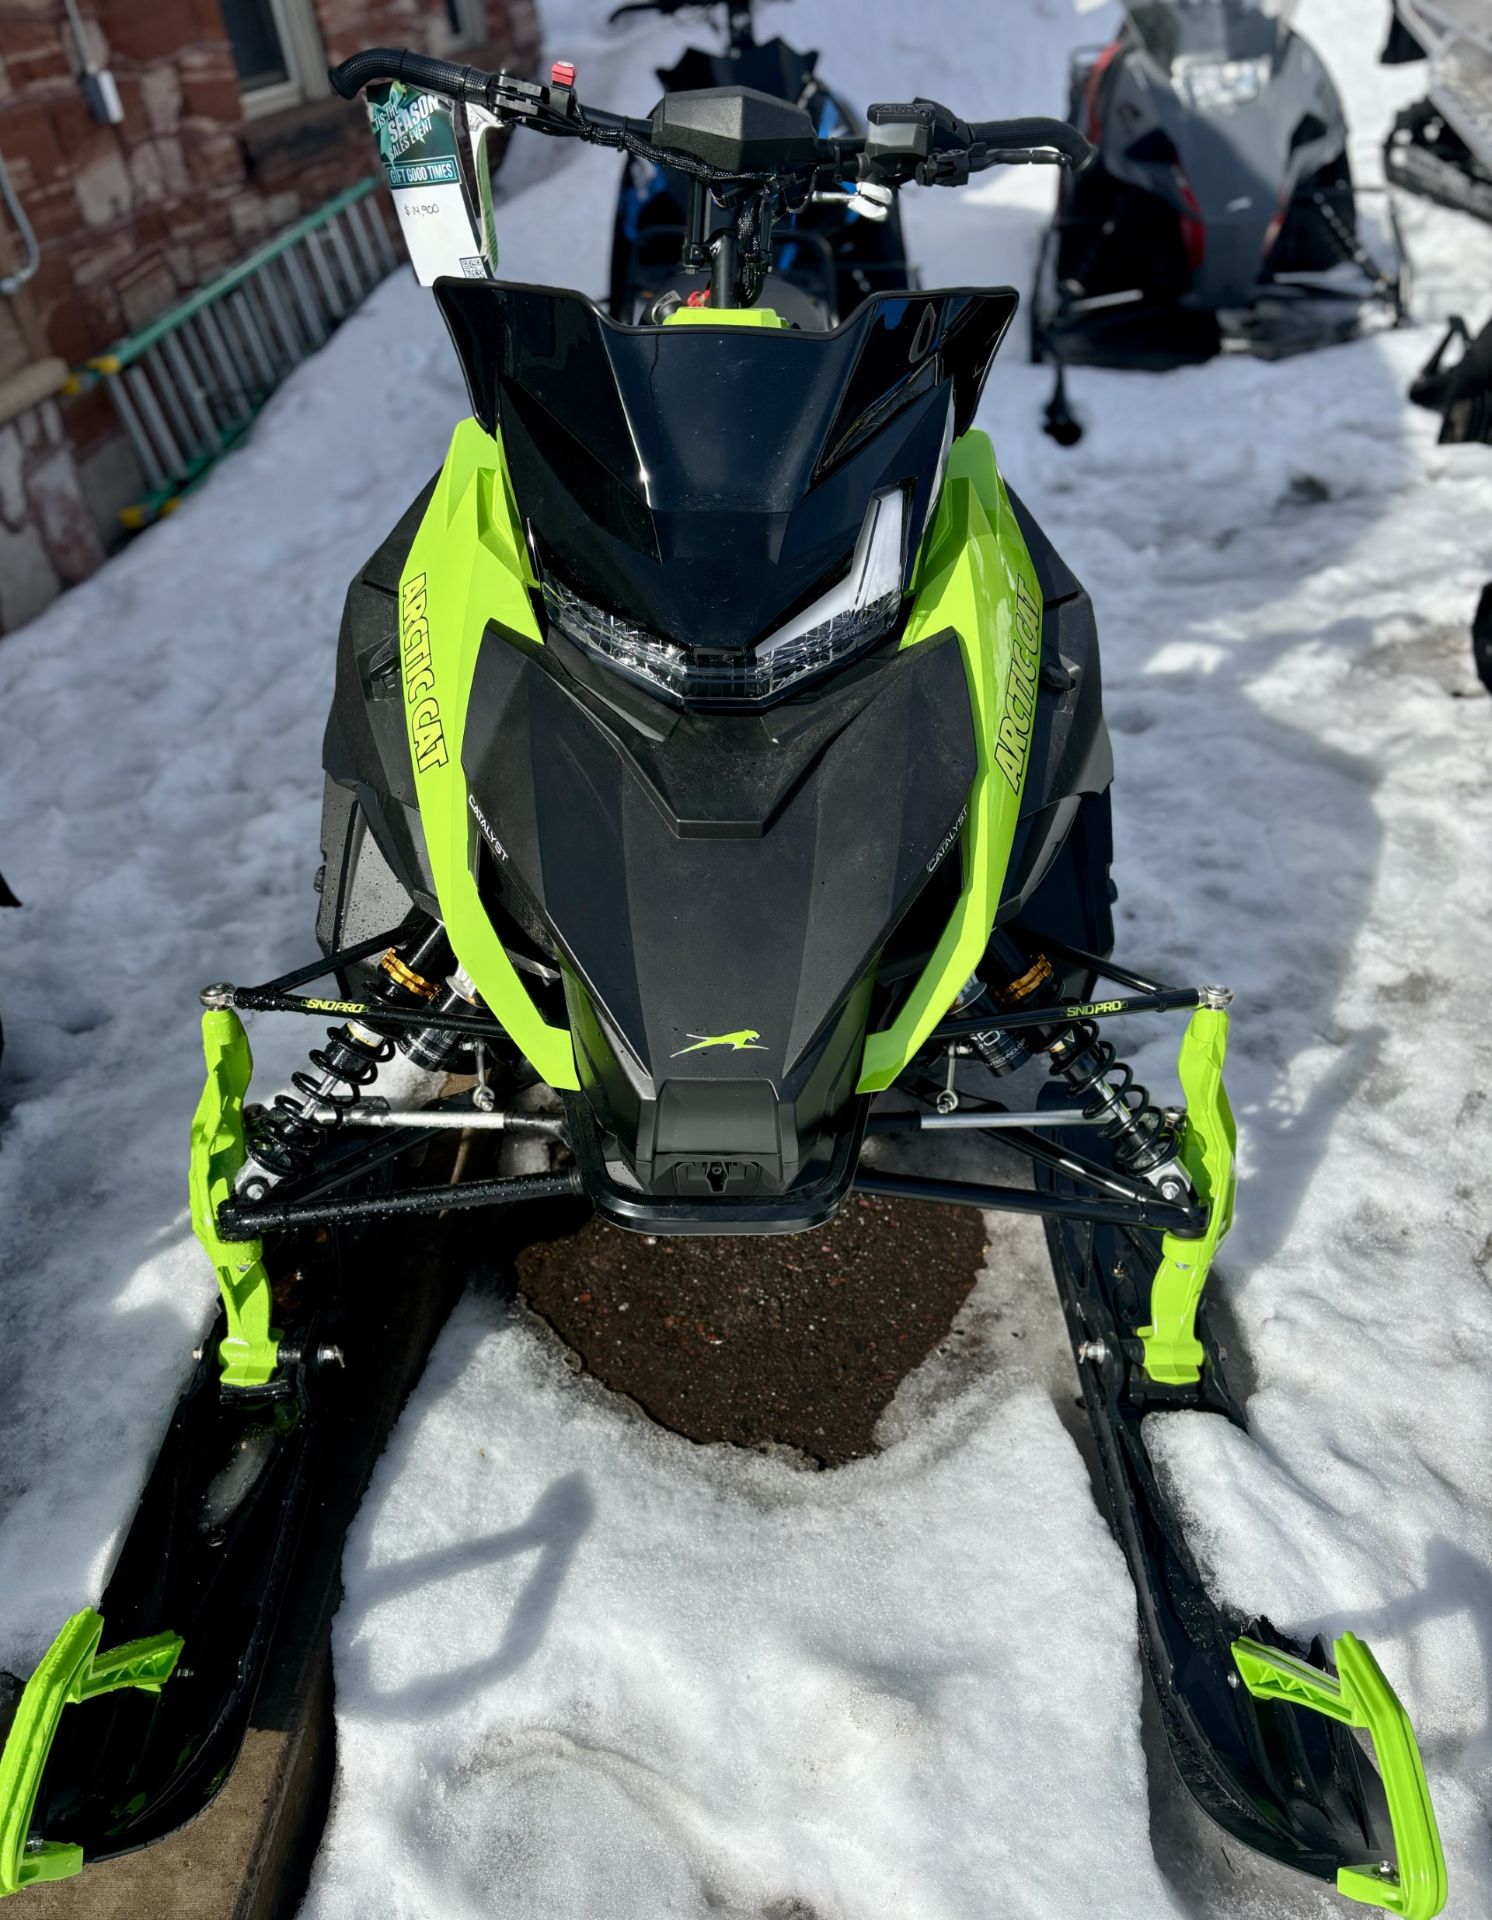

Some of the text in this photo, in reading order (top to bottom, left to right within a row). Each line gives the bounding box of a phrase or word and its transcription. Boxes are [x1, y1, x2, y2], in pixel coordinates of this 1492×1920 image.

[388, 94, 440, 144] SEASON
[388, 116, 434, 161] SALES EVENT
[390, 163, 453, 184] GIFT GOOD TIMES
[402, 571, 449, 774] ARCTIC CAT
[994, 572, 1040, 796] ARCTIC CAT
[469, 794, 510, 862] CATALYST
[928, 803, 968, 873] CATALYST
